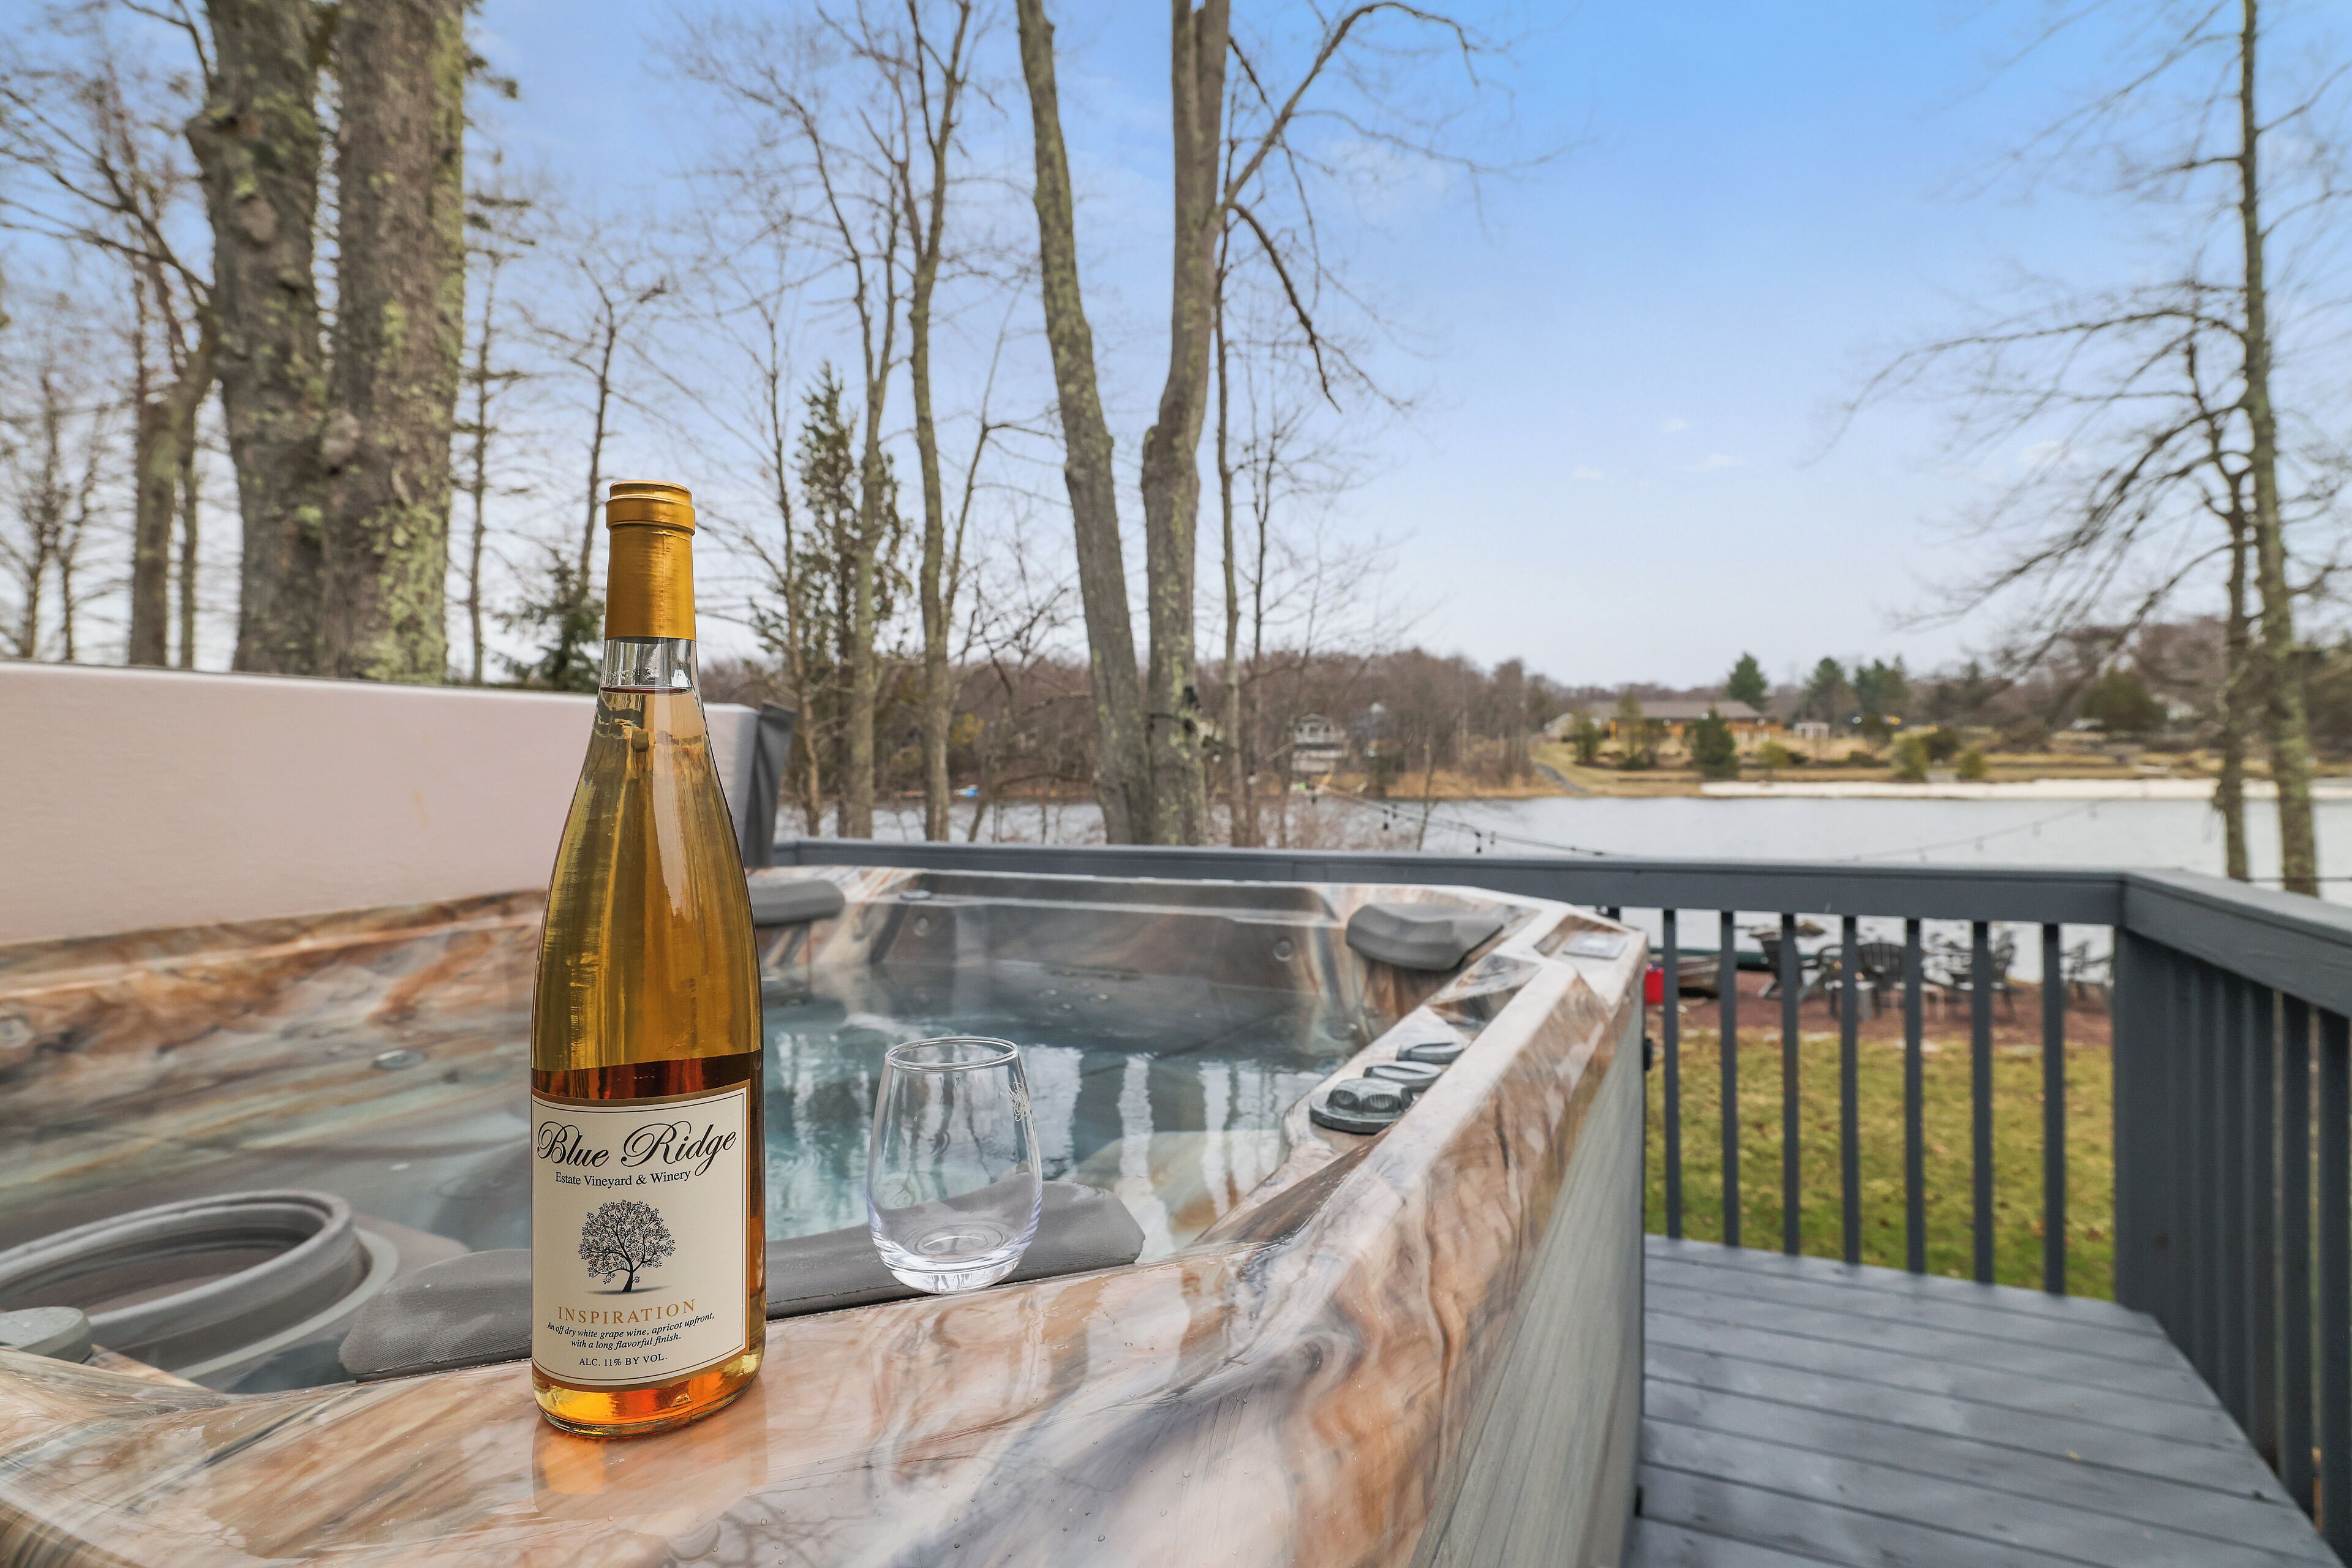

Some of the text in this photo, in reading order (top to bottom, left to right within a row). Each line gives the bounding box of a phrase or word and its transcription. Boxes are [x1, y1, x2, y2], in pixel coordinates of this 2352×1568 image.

[537, 1120, 737, 1177] Blue Ridge
[555, 1170, 692, 1189] Estate Vineyard & Winery
[558, 1298, 696, 1324] INSPIRATION
[547, 1313, 715, 1340] An off dry white grape wine, apricot upfront,
[571, 1340, 587, 1348] with
[595, 1341, 613, 1351] long
[614, 1337, 653, 1351] flavorful
[654, 1332, 682, 1346] finish.
[579, 1353, 668, 1366] ALC. 11% BY VOL.
